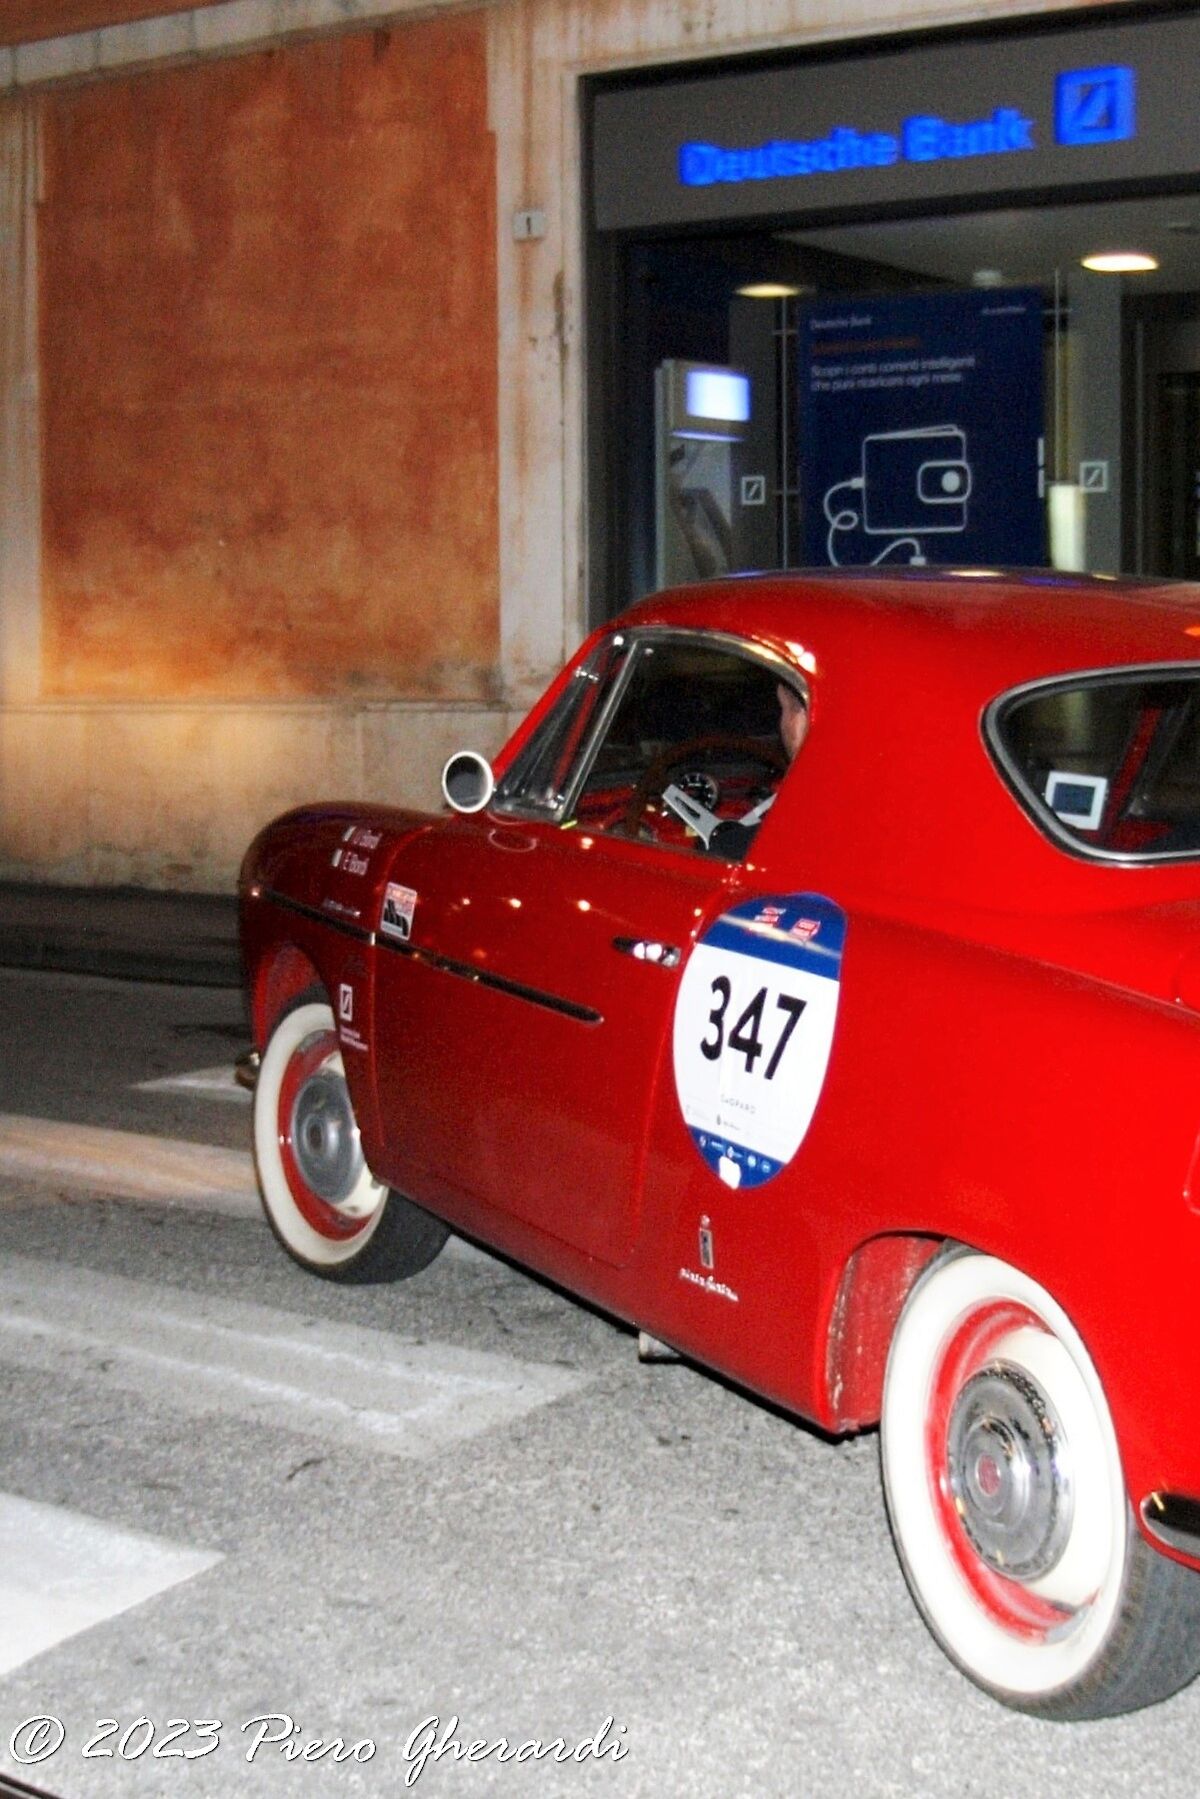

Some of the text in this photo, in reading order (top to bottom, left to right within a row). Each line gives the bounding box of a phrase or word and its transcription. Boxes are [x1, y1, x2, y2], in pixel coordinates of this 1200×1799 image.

[679, 106, 1034, 186] Deutsche Bank
[700, 975, 808, 1080] 347
